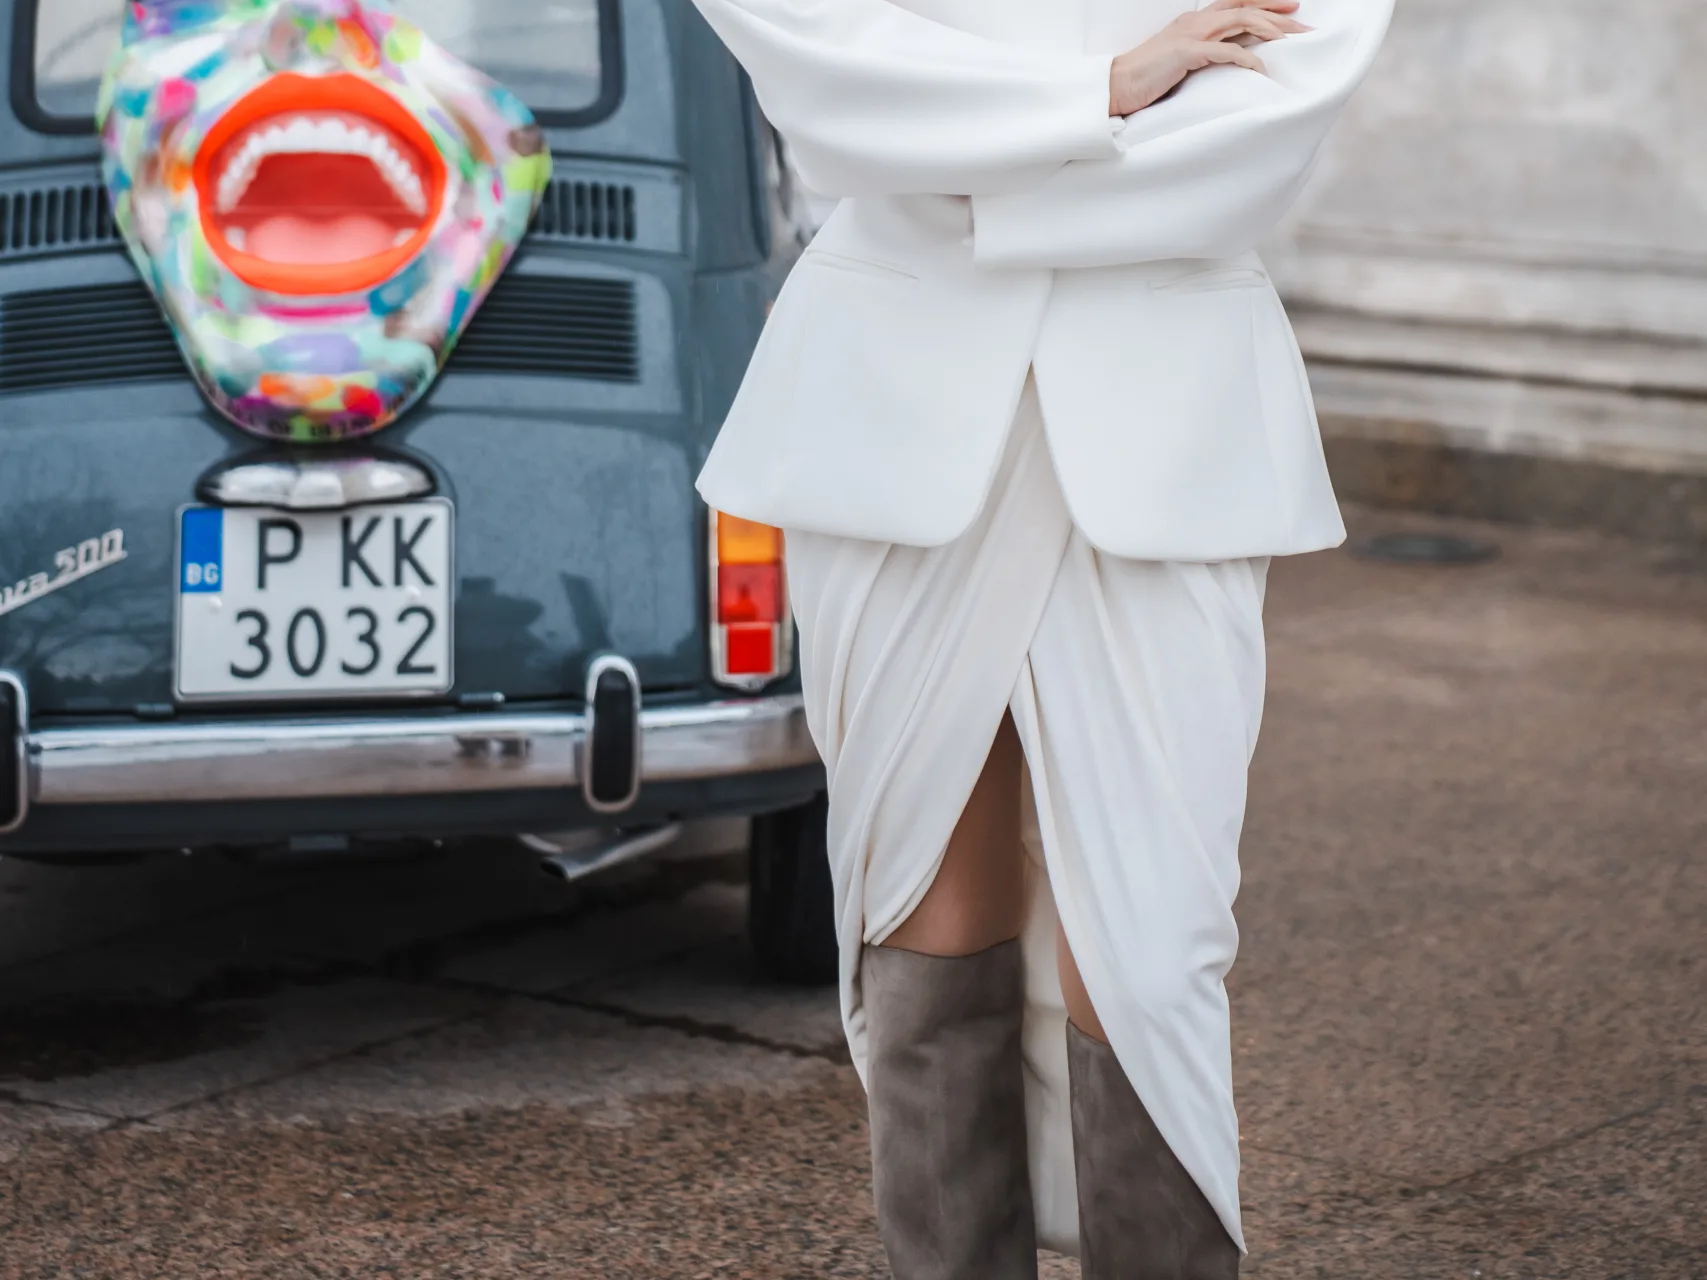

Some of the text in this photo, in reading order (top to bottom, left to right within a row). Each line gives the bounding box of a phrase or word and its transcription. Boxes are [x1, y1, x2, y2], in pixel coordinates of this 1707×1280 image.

[54, 528, 124, 578] 500
[185, 562, 219, 586] BG
[257, 516, 435, 590] P KK
[229, 606, 437, 679] 3032
